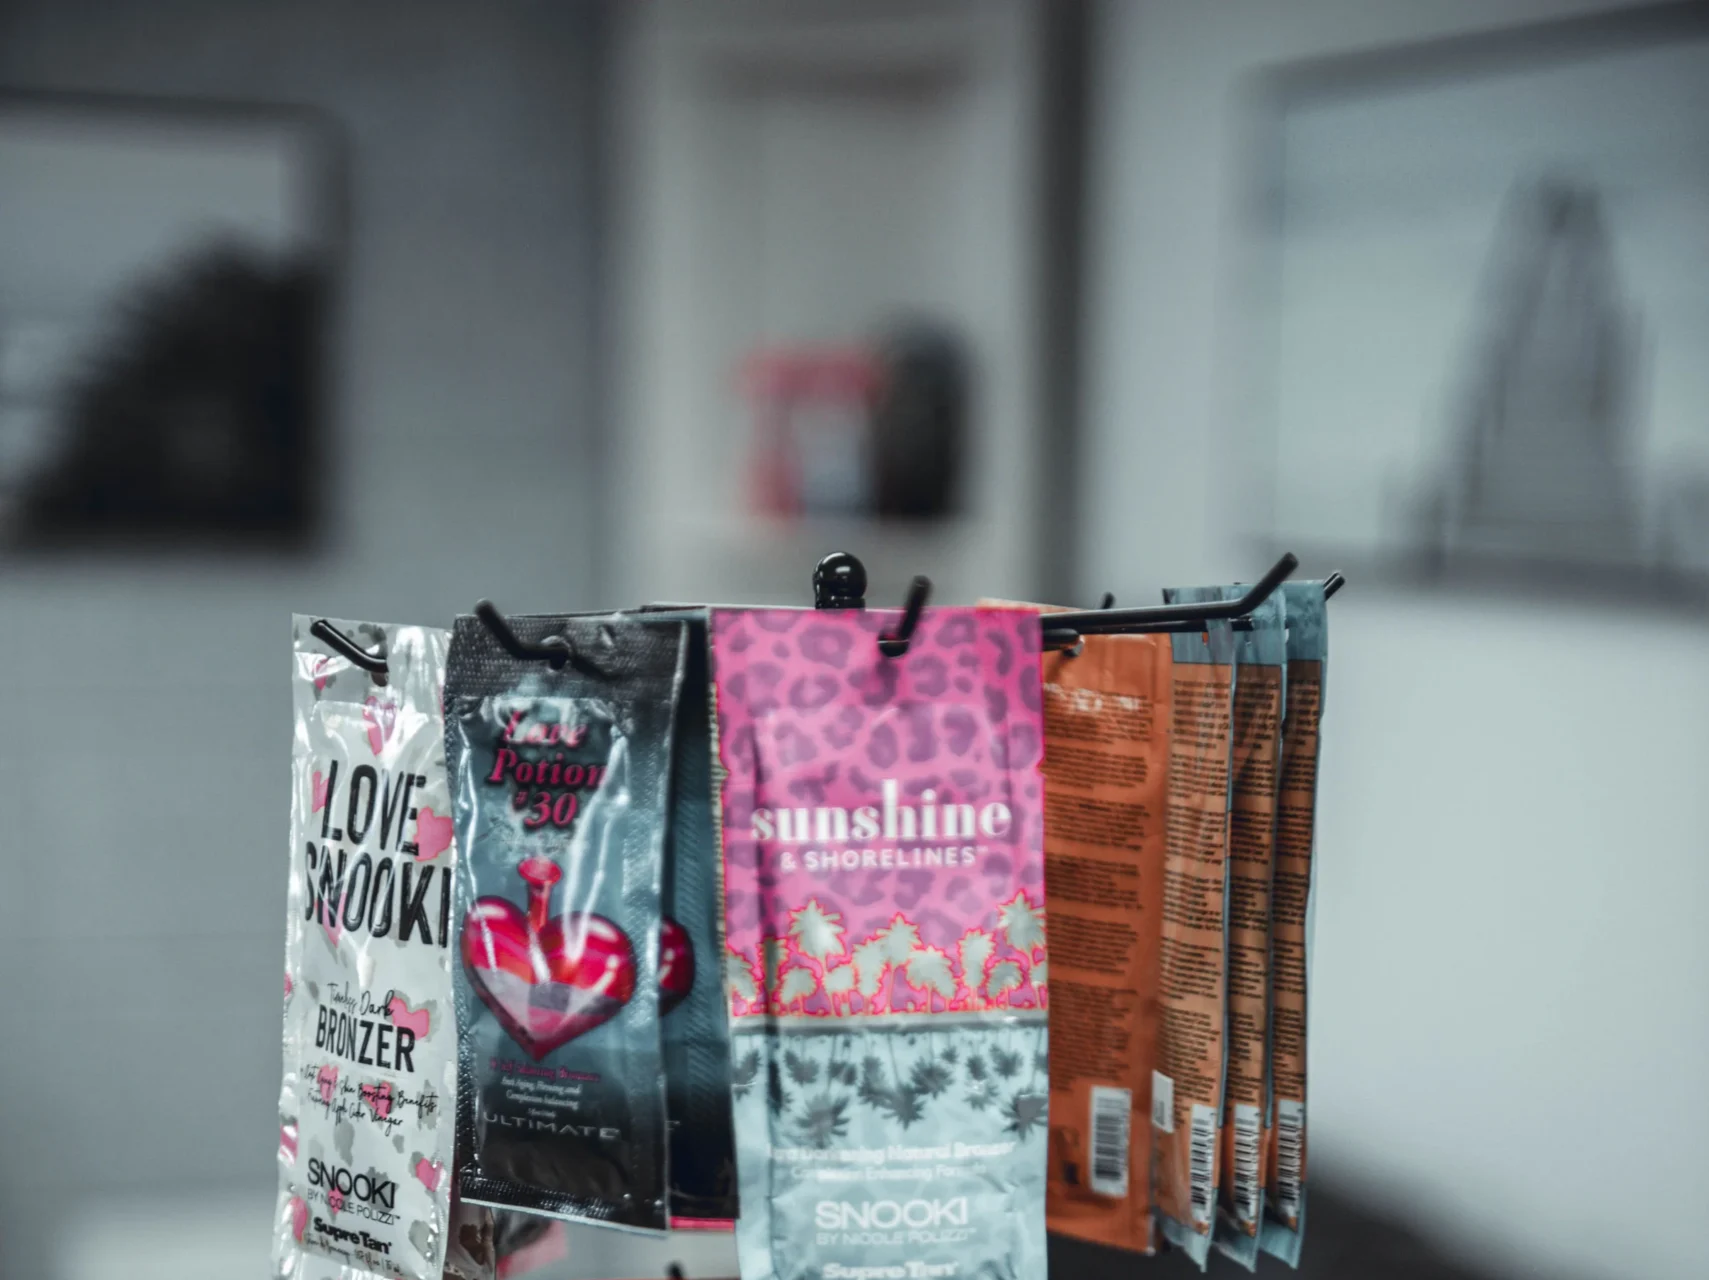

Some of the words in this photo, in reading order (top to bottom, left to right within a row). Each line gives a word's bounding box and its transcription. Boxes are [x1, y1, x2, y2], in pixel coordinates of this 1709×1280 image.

[488, 747, 609, 787] Potion
[320, 760, 427, 857] LOVE
[514, 780, 578, 829] #30
[750, 778, 1013, 843] sunshine
[780, 850, 797, 872] &
[805, 845, 977, 870] SHORELINES
[304, 840, 451, 949] SNOOKI
[359, 988, 395, 1017] Dark
[315, 1003, 416, 1074] BRONZER
[483, 1110, 622, 1141] ULTIMATE
[308, 1156, 396, 1209] SNOOKI
[814, 1196, 969, 1230] SNOOKI
[815, 1232, 840, 1246] BY
